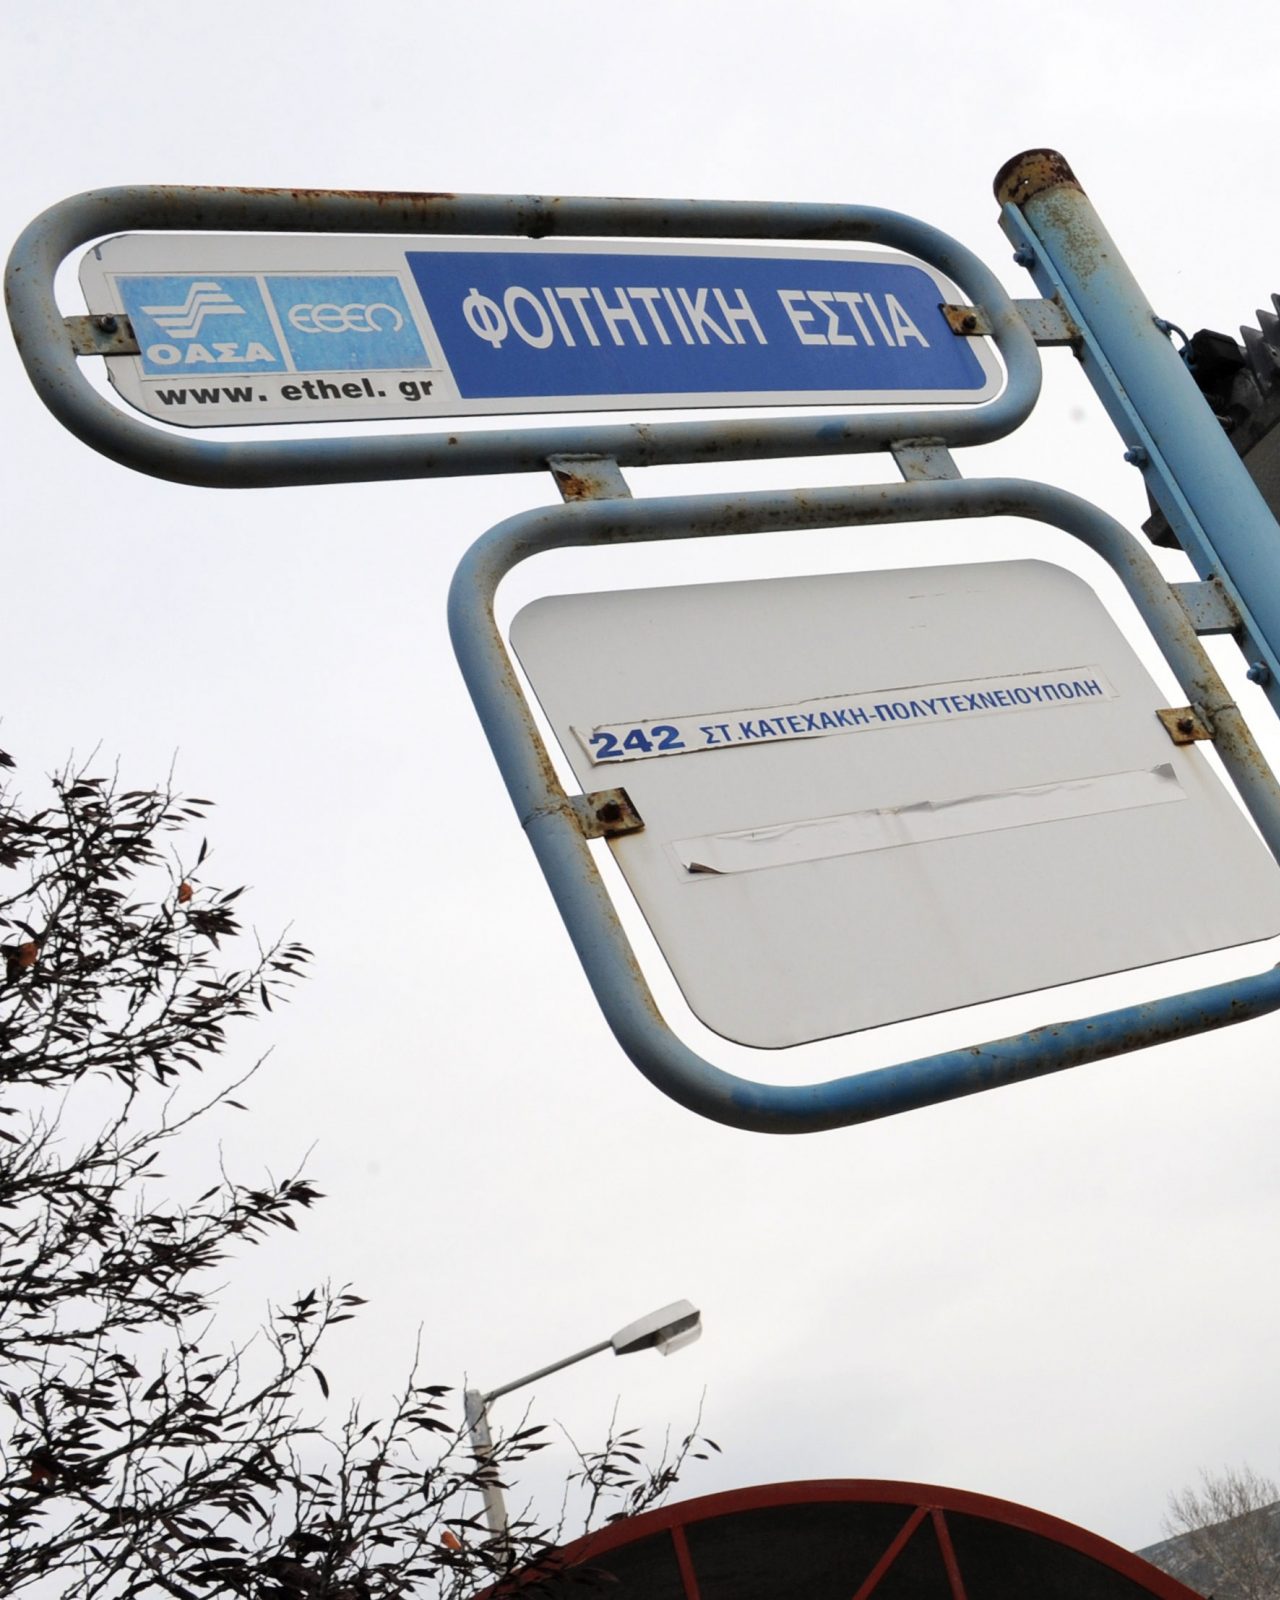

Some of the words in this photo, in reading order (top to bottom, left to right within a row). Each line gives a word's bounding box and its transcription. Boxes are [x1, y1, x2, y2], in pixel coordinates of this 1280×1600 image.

[461, 286, 767, 349] ΦΟΙΤΗΤΙΚΗ
[776, 288, 930, 348] ΕΣΤΙΑ
[146, 343, 276, 366] ΟΑΣΑ
[589, 725, 686, 759] 242
